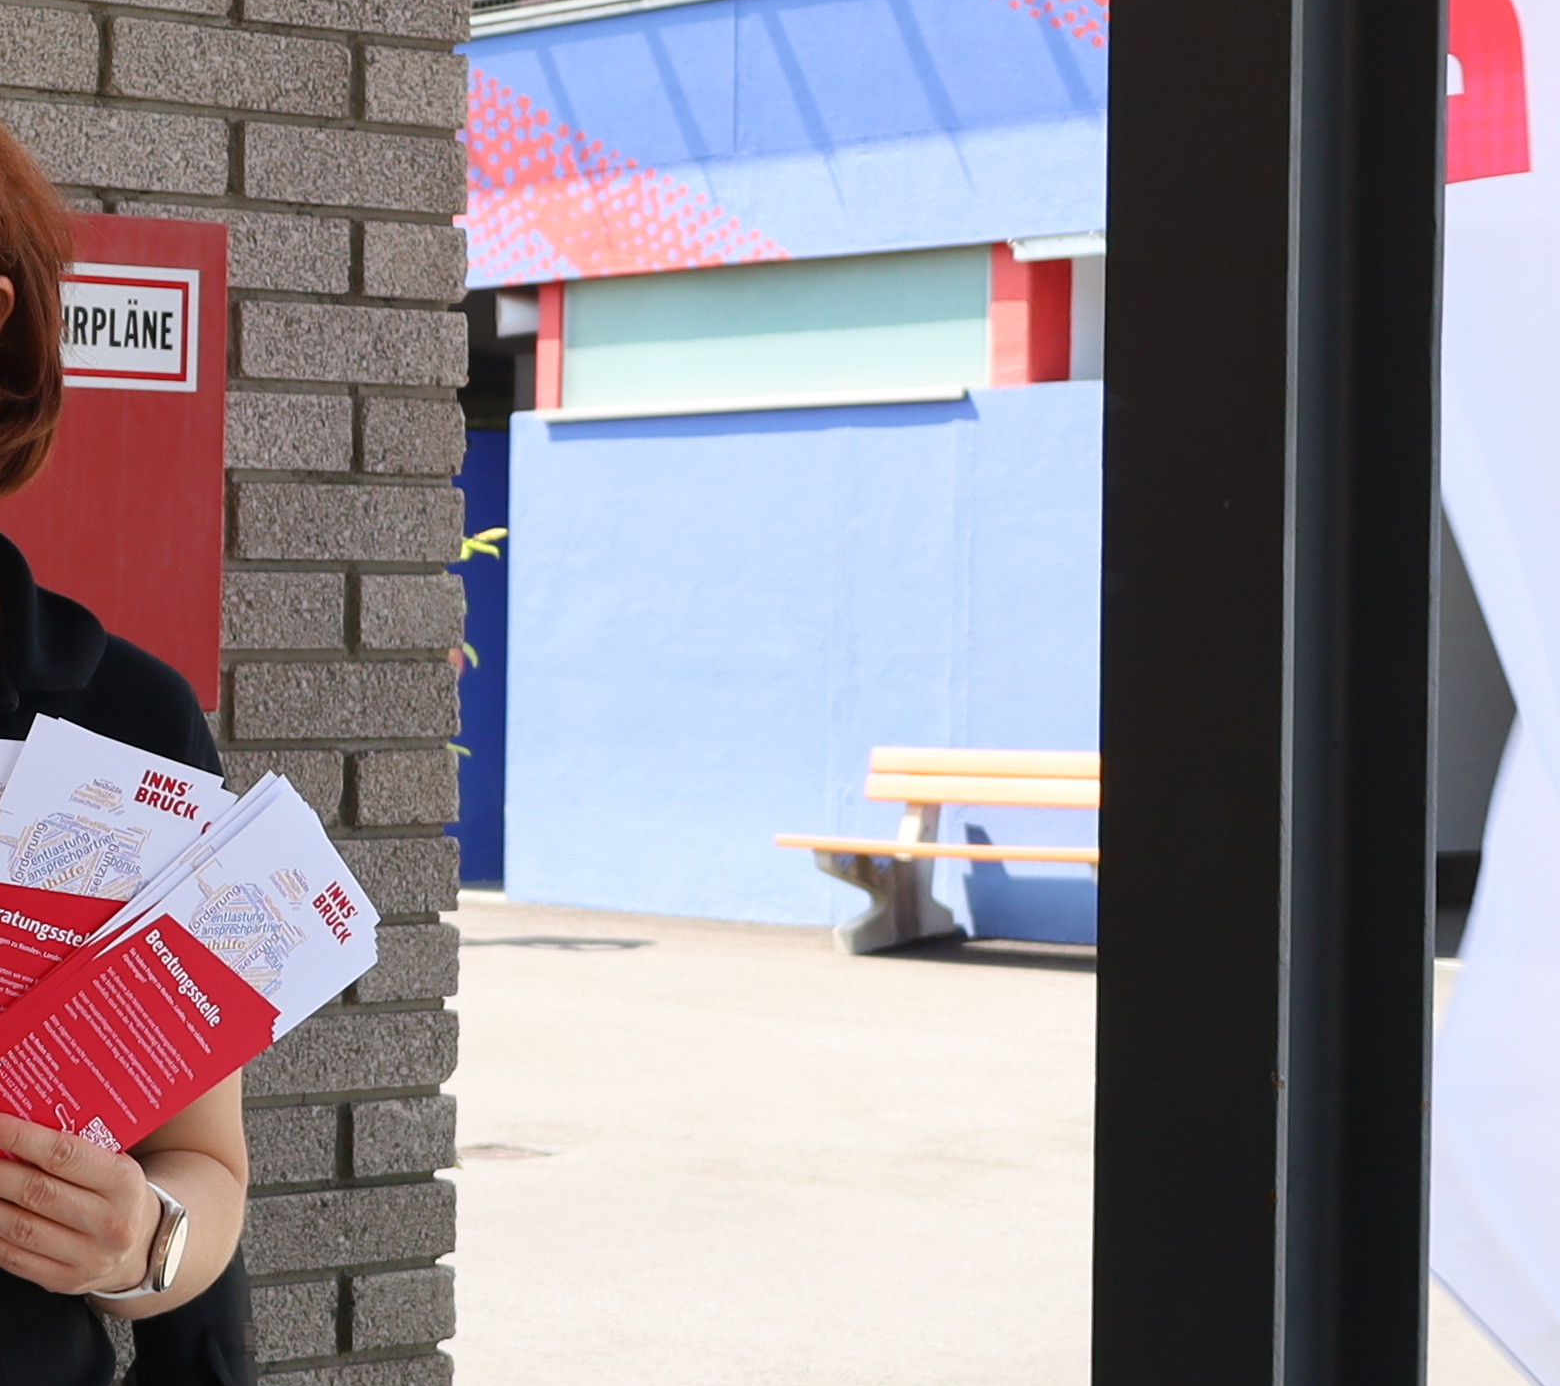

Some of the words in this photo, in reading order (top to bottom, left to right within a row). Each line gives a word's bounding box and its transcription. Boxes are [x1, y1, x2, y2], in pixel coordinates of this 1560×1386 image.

[141, 770, 194, 797] INNS'
[134, 787, 199, 820] BRUCK
[11, 822, 48, 883] förderung
[28, 833, 116, 881] ansprechpartner
[31, 832, 90, 866] entlastung
[111, 857, 141, 874] bonus
[188, 884, 241, 932] förderung
[211, 912, 265, 923] entlastung
[324, 880, 358, 918] INNS'
[201, 923, 283, 936] ansprechpartner
[312, 893, 352, 945] BRUCK
[235, 933, 279, 975] setzung
[145, 928, 221, 1028] Beratungsstelle
